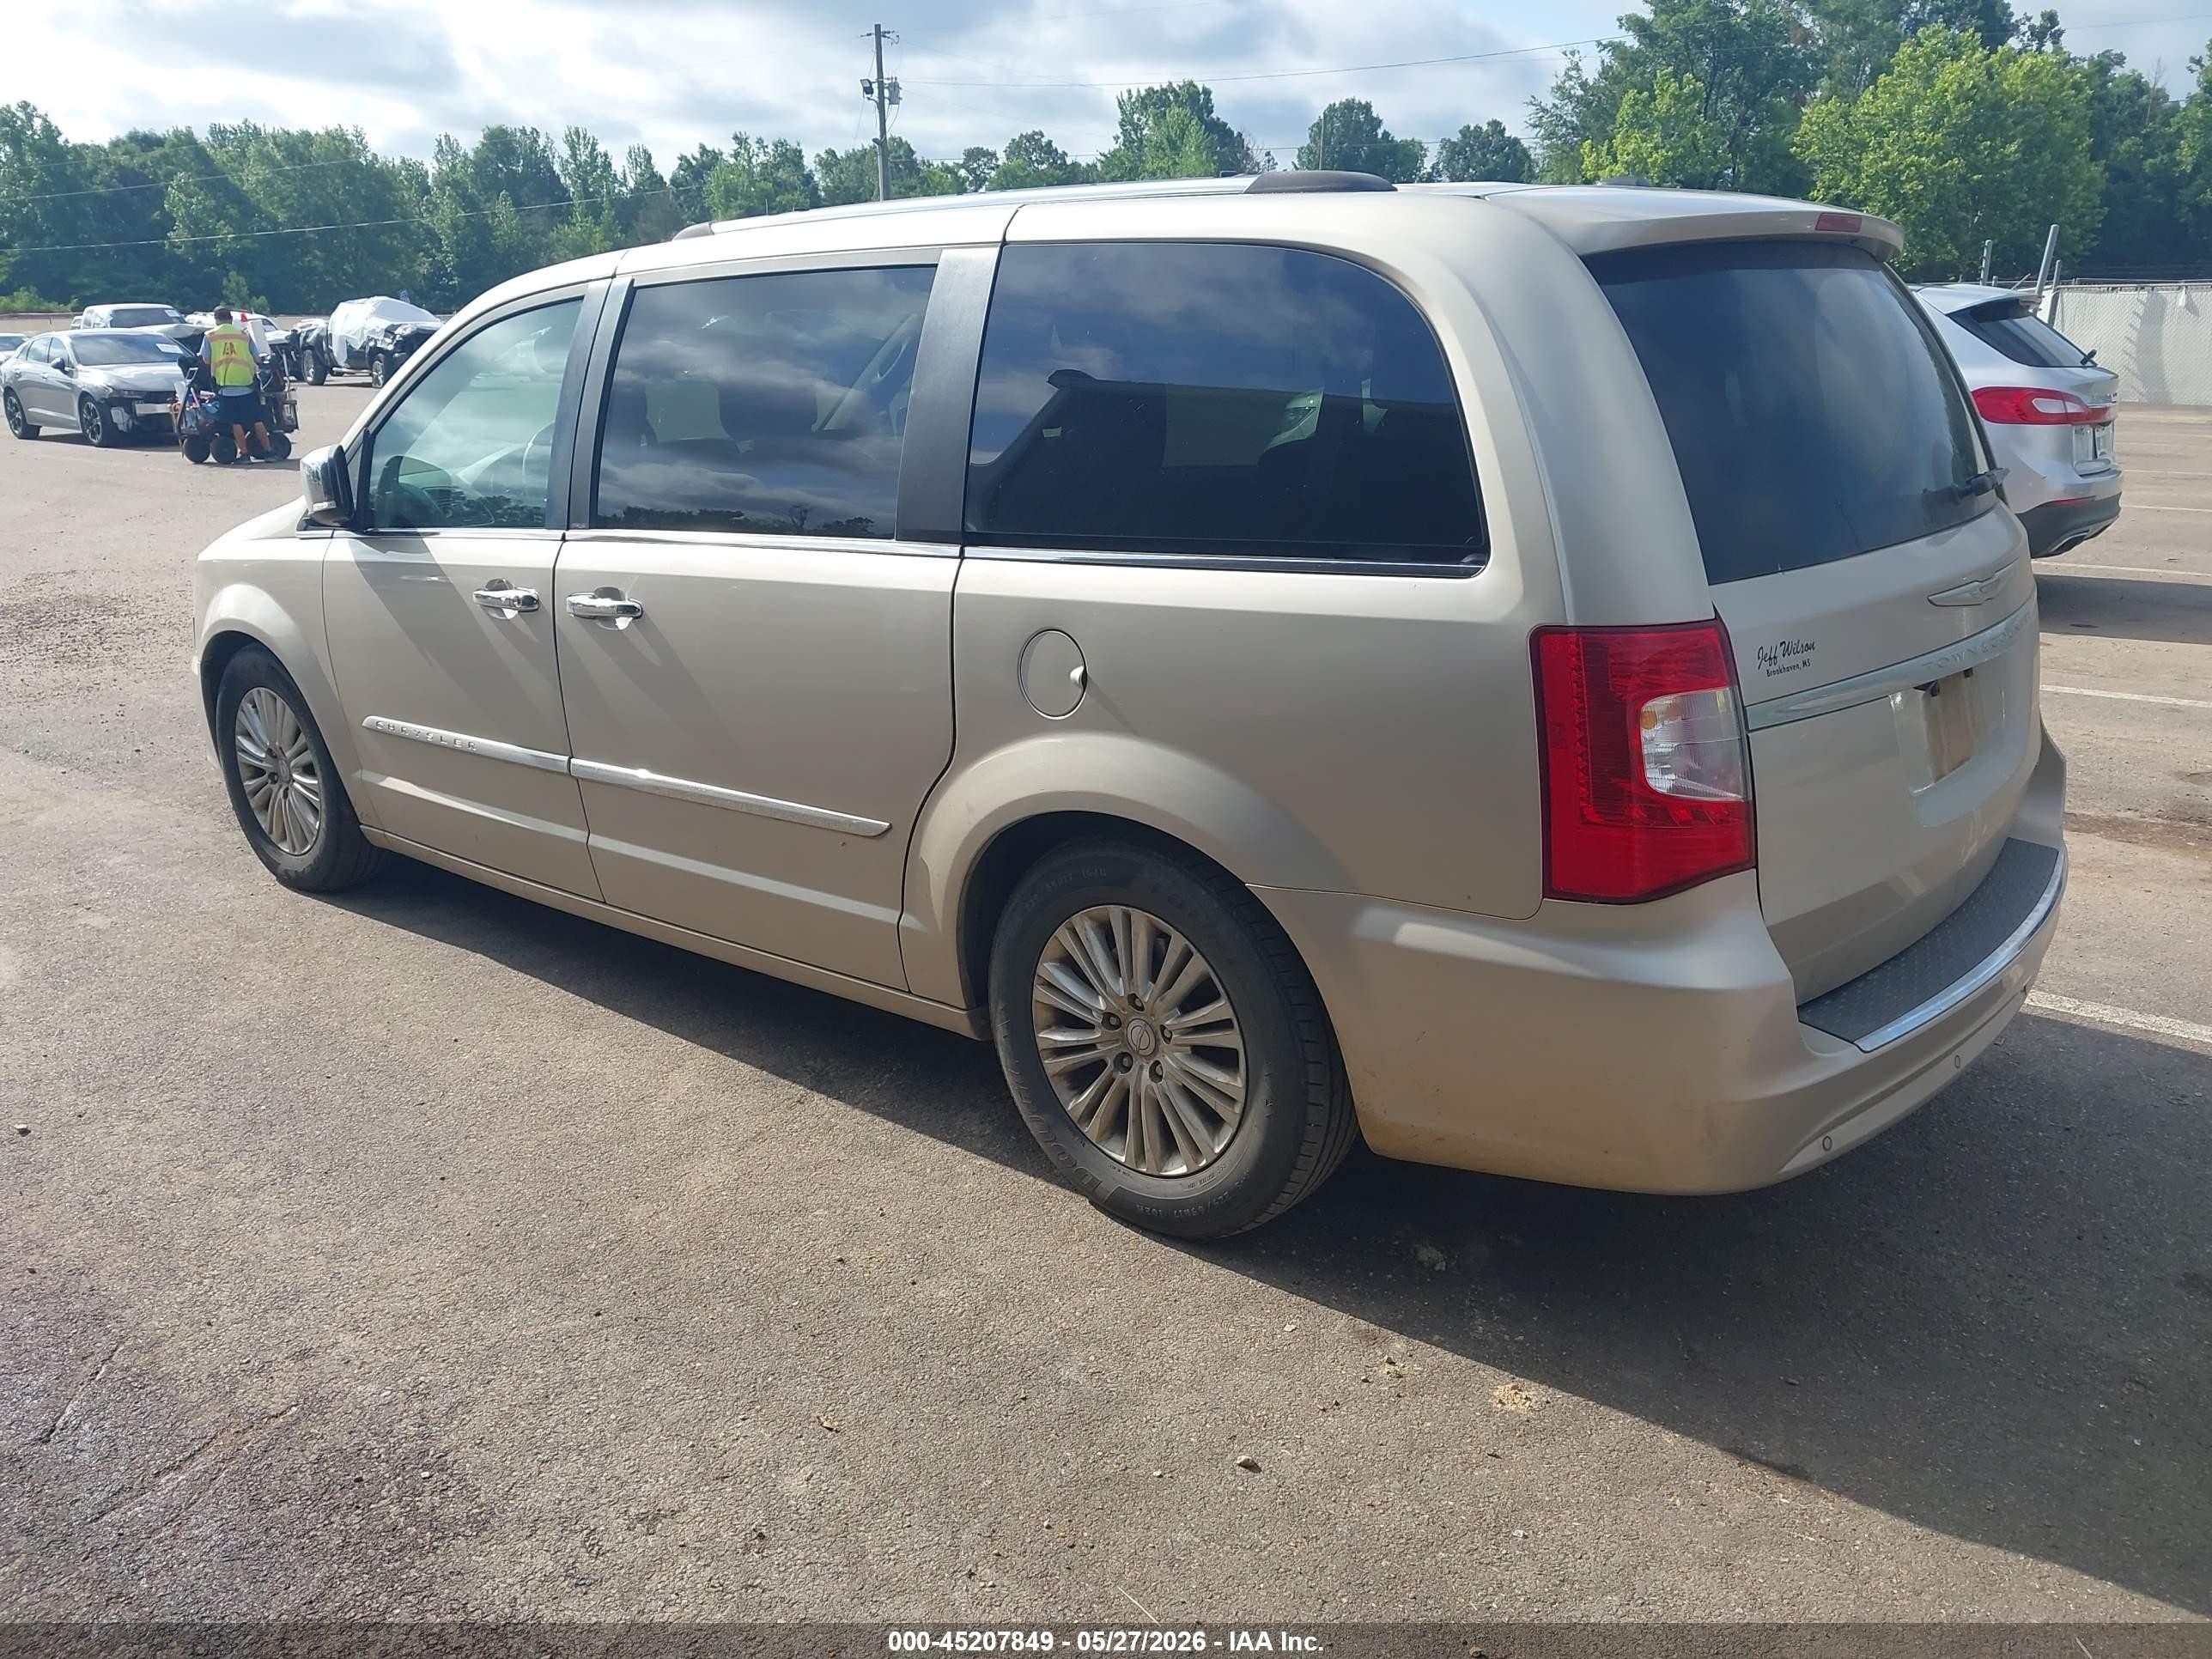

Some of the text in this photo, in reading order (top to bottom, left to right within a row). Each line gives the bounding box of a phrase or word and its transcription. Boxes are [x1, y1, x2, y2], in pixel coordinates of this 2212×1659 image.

[1757, 639, 1815, 670] Jeff Wilson
[1802, 659, 1811, 667] MS
[375, 720, 477, 751] CHRYSLER
